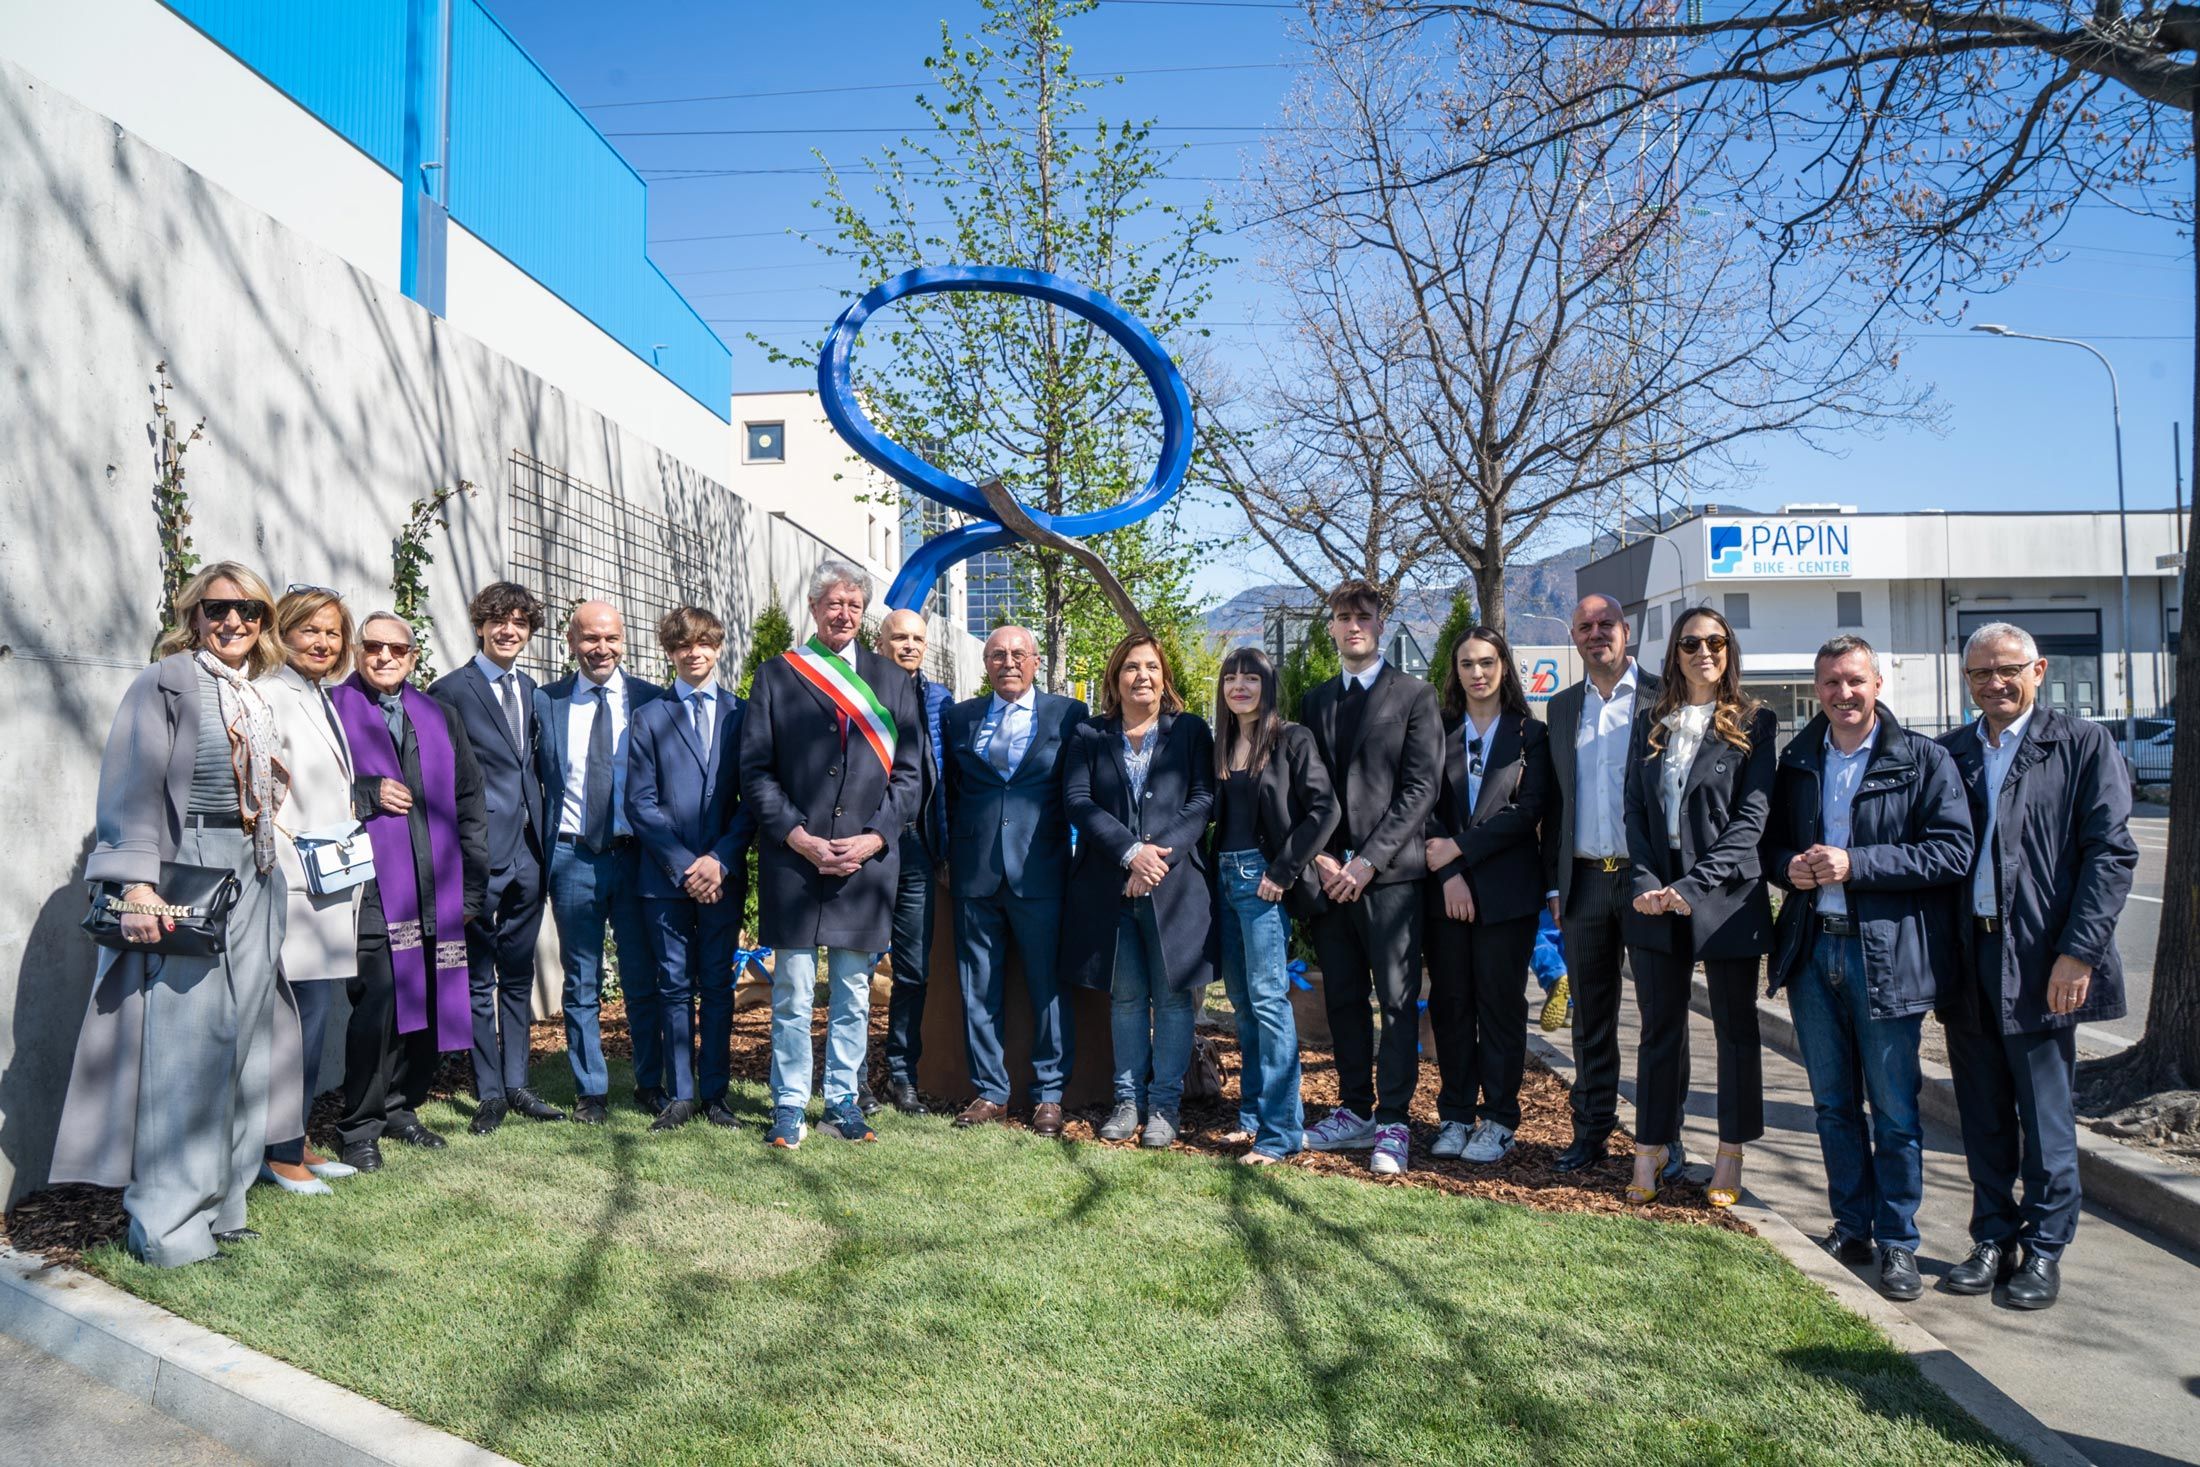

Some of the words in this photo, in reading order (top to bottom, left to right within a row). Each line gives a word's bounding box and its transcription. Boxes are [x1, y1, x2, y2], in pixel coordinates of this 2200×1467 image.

[1752, 525, 1848, 556] PAPIN
[1753, 561, 1785, 573] BIKE
[1797, 560, 1850, 573] CENTER
